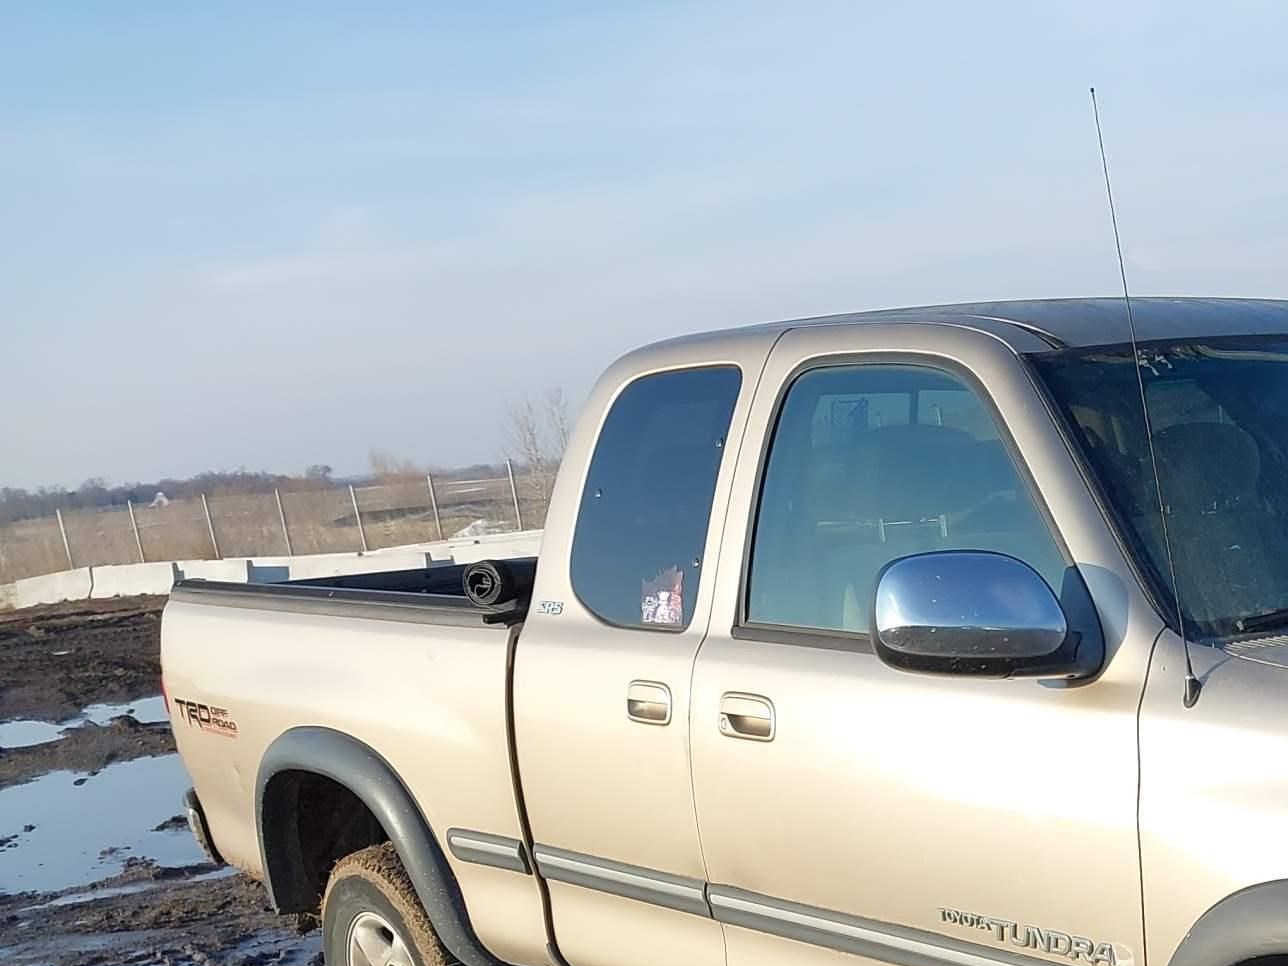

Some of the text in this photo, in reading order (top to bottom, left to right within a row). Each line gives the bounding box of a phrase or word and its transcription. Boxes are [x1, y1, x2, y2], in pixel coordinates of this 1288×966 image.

[175, 698, 228, 728] TRD OFF
[212, 718, 236, 730] ROAD
[937, 907, 992, 930] TOYOTA
